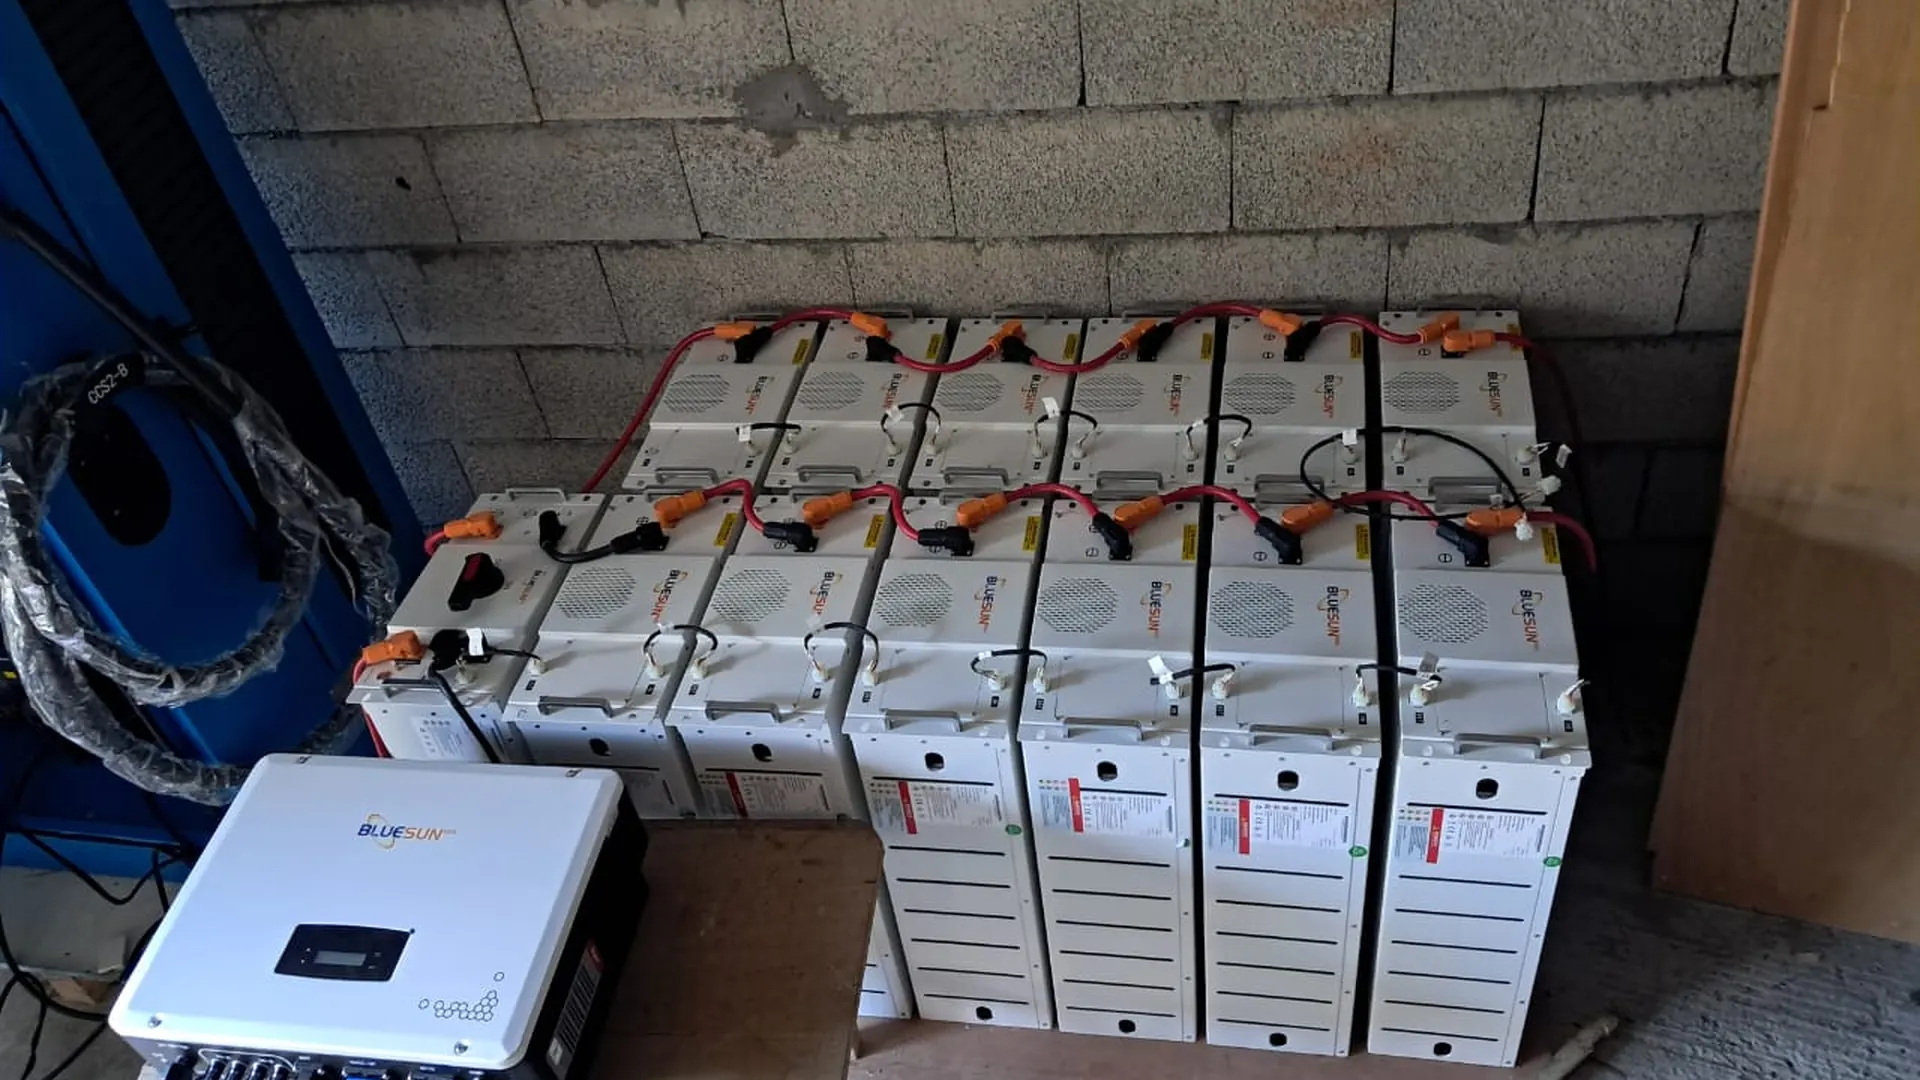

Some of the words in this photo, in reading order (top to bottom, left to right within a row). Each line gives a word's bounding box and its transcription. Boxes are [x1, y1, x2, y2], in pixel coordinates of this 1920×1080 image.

[1487, 371, 1501, 411] BLUESUN
[651, 569, 681, 619] BLUESUN
[978, 576, 998, 626] BLUESUN
[1148, 580, 1163, 631] BLUESUN
[1326, 585, 1340, 637] BLUESUN
[1519, 589, 1538, 643] BLUESUN
[357, 823, 443, 841] BLUESUN
